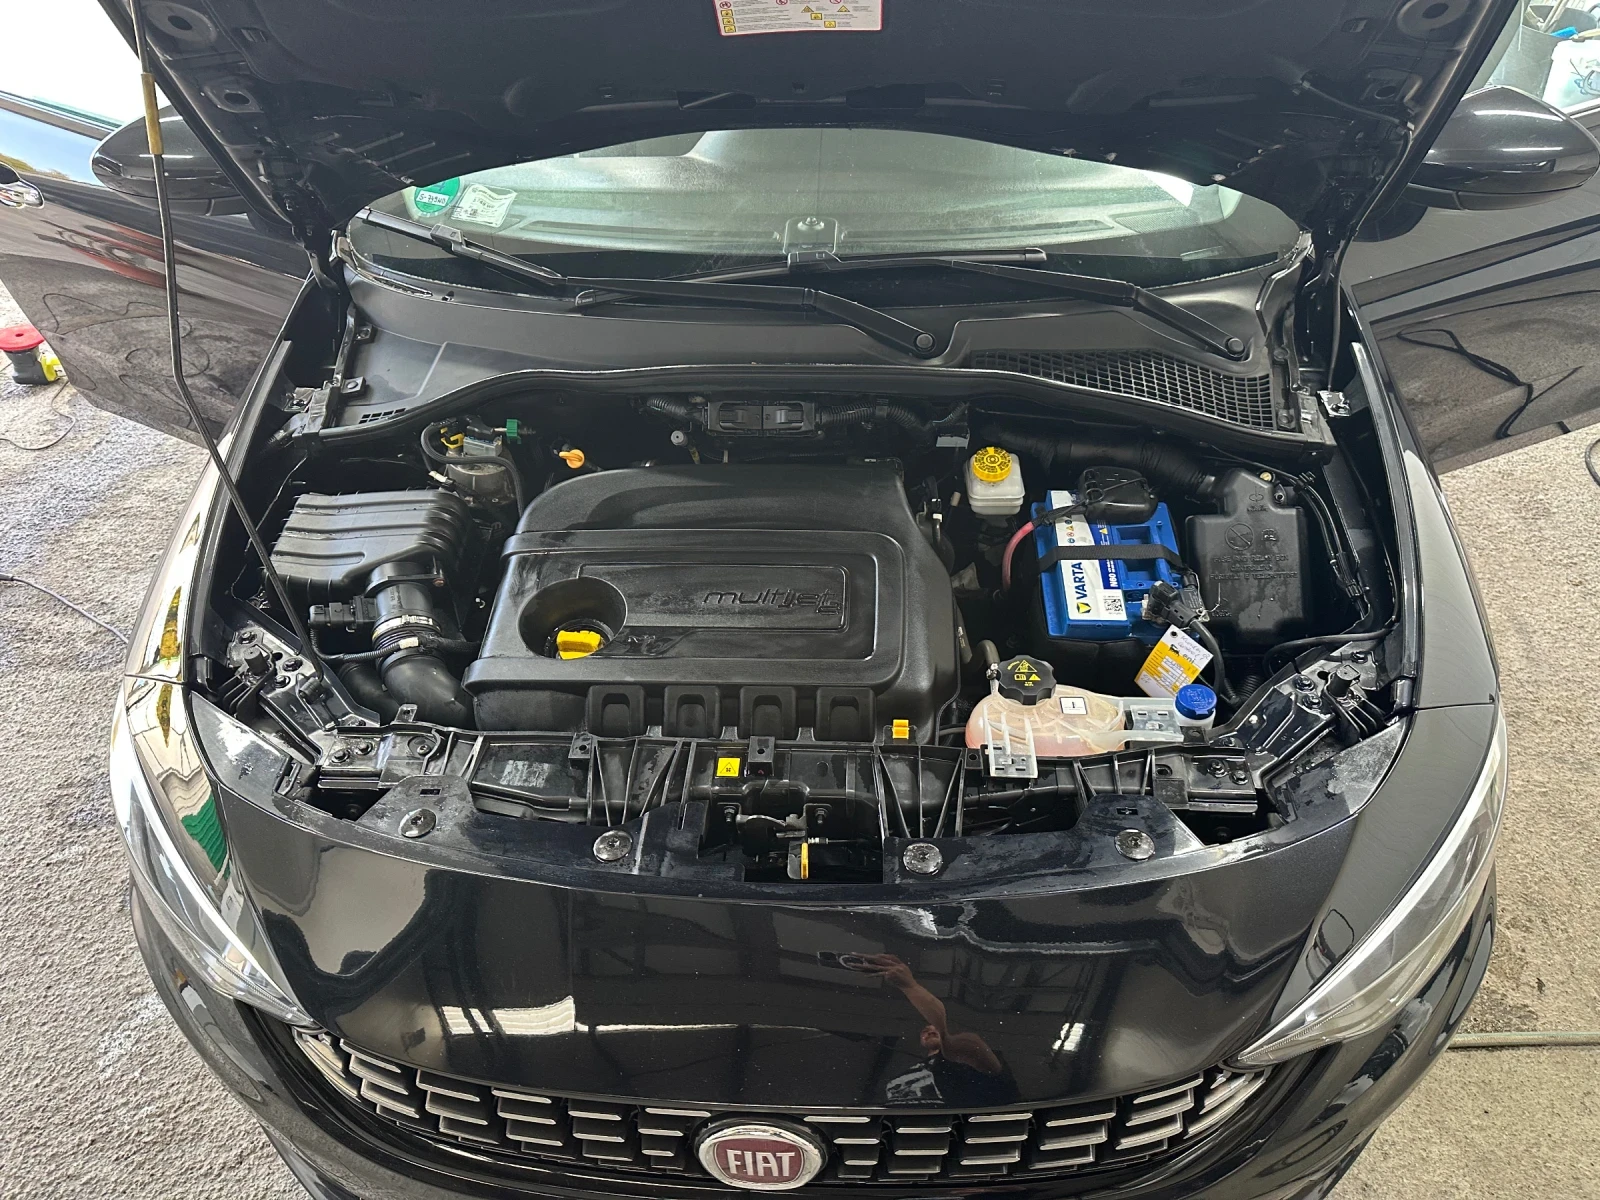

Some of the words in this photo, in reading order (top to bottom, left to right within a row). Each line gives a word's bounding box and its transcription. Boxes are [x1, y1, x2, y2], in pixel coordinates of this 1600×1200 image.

[1071, 562, 1088, 600] VARTA
[1108, 573, 1119, 588] N60
[1183, 653, 1195, 664] eni
[726, 1149, 796, 1177] FIAT
